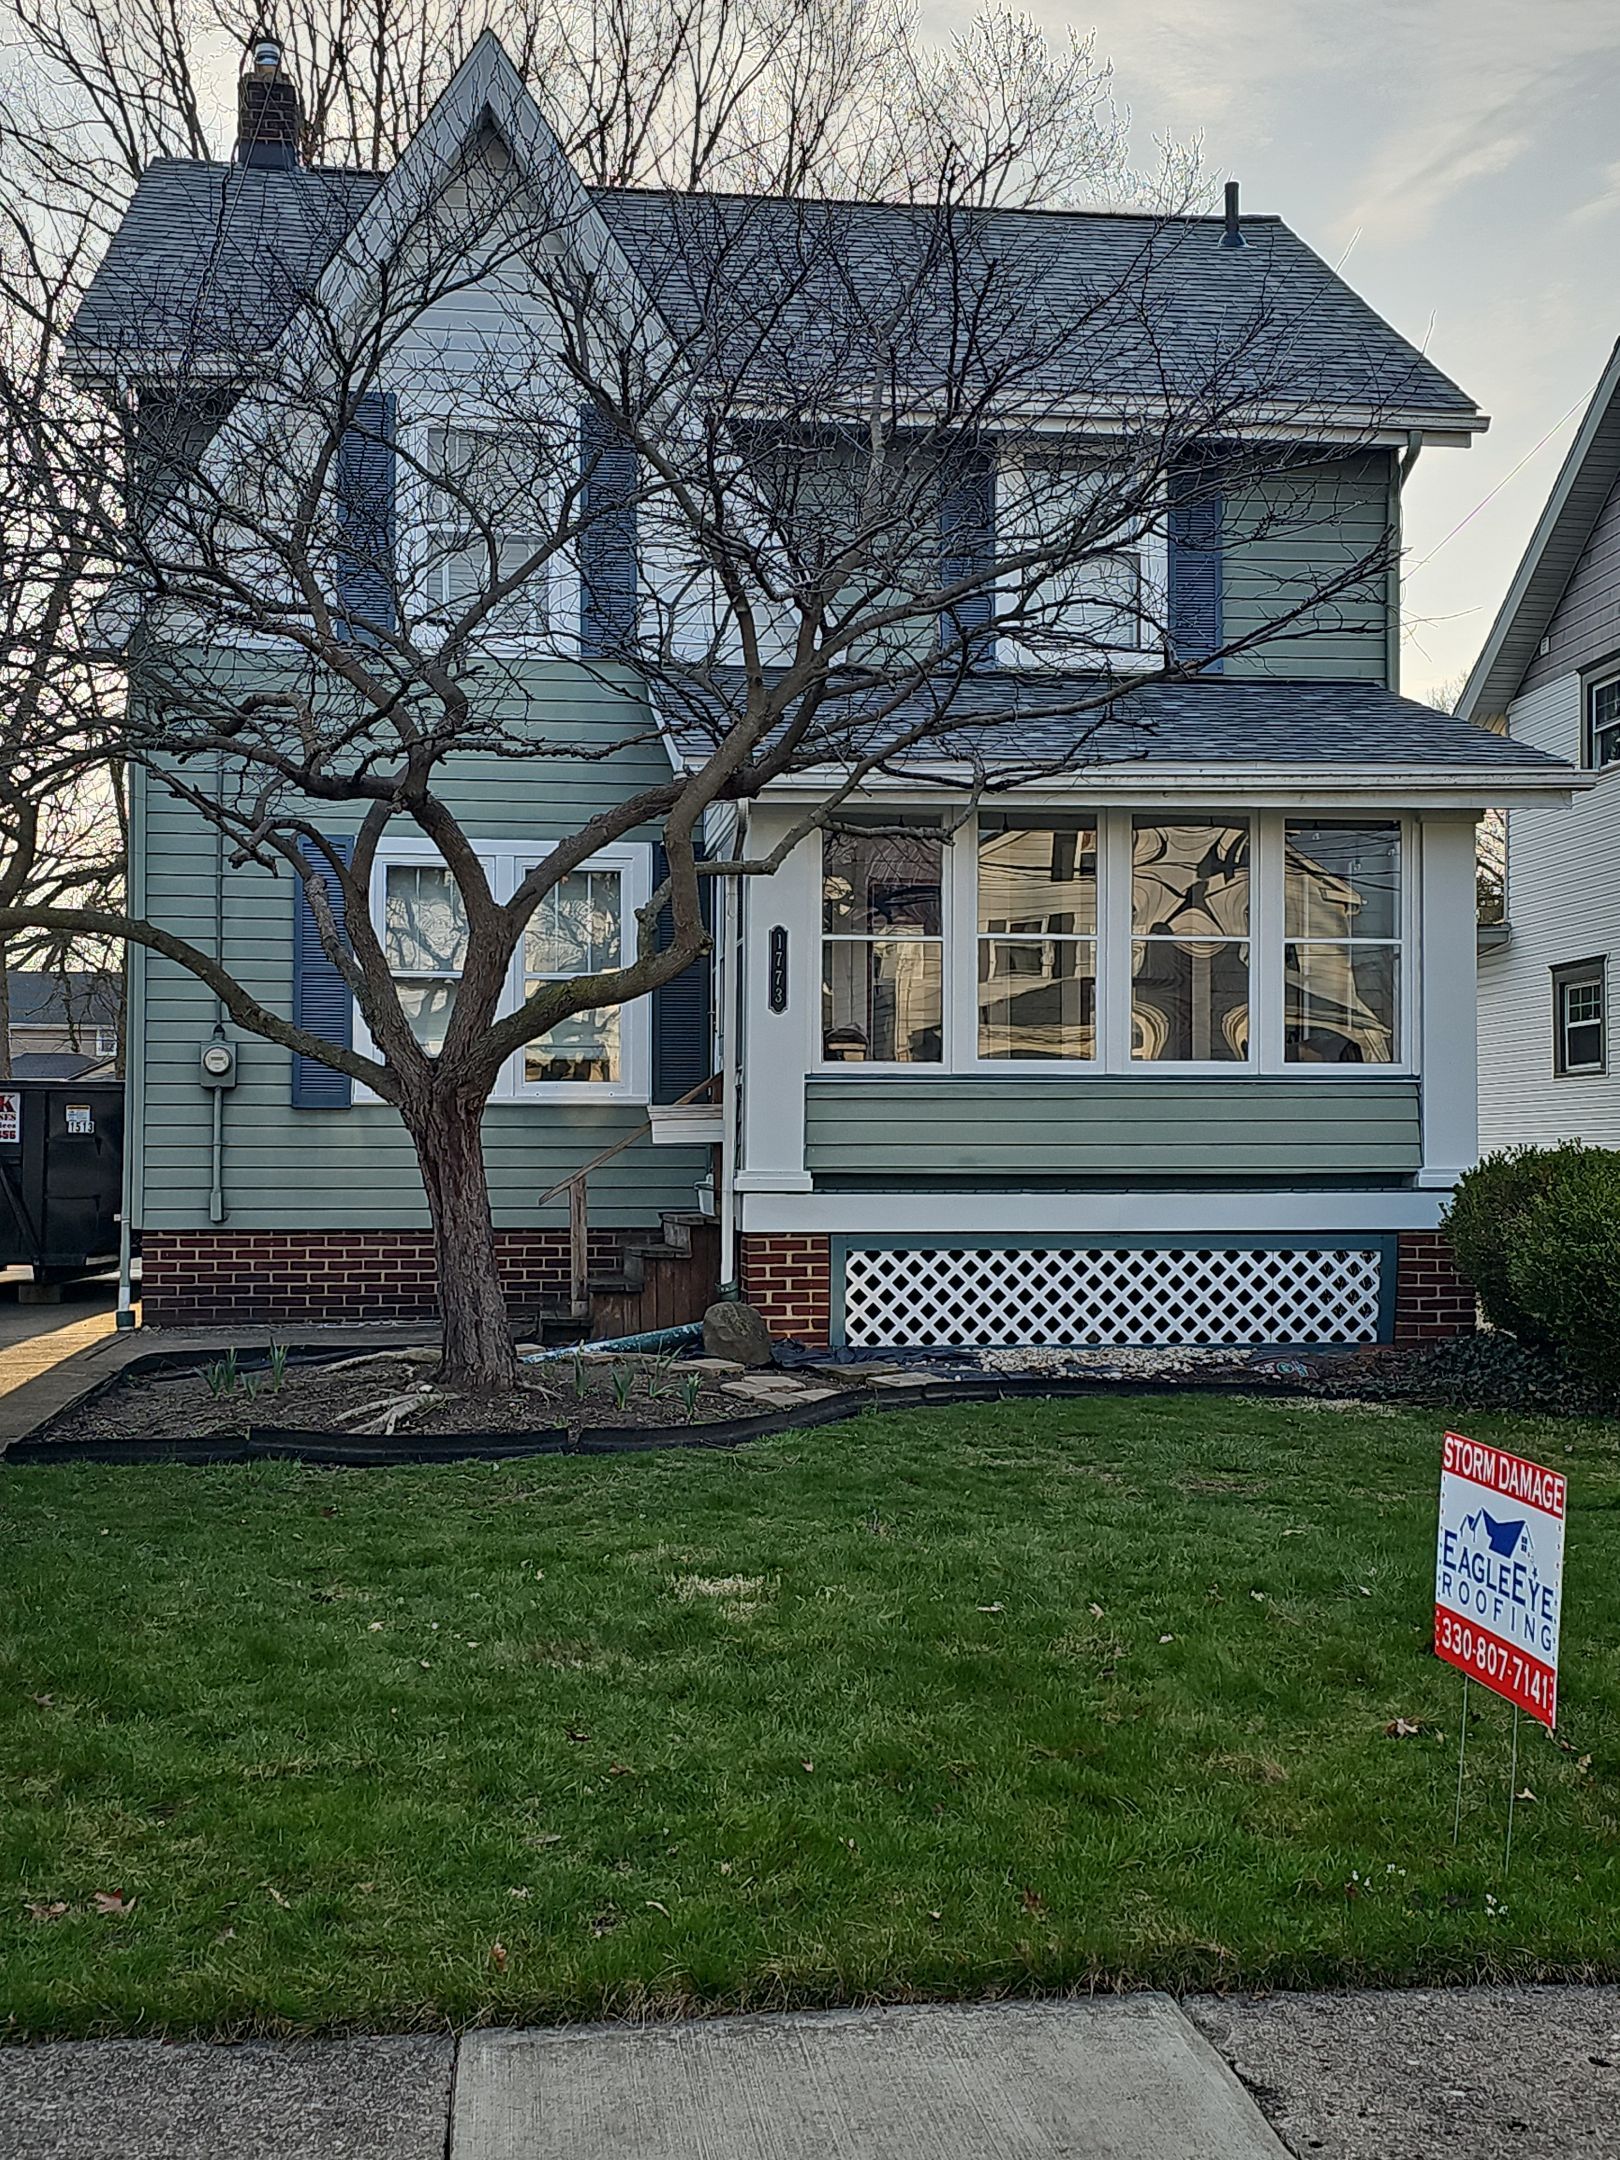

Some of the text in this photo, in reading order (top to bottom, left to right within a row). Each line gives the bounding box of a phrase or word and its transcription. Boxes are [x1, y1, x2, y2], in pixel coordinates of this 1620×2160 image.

[775, 933, 783, 1003] 1773
[1443, 1436, 1564, 1514] STORM DAMAGE
[1442, 1571, 1551, 1651] ROOFING
[1442, 1617, 1547, 1709] 330-807-7141
